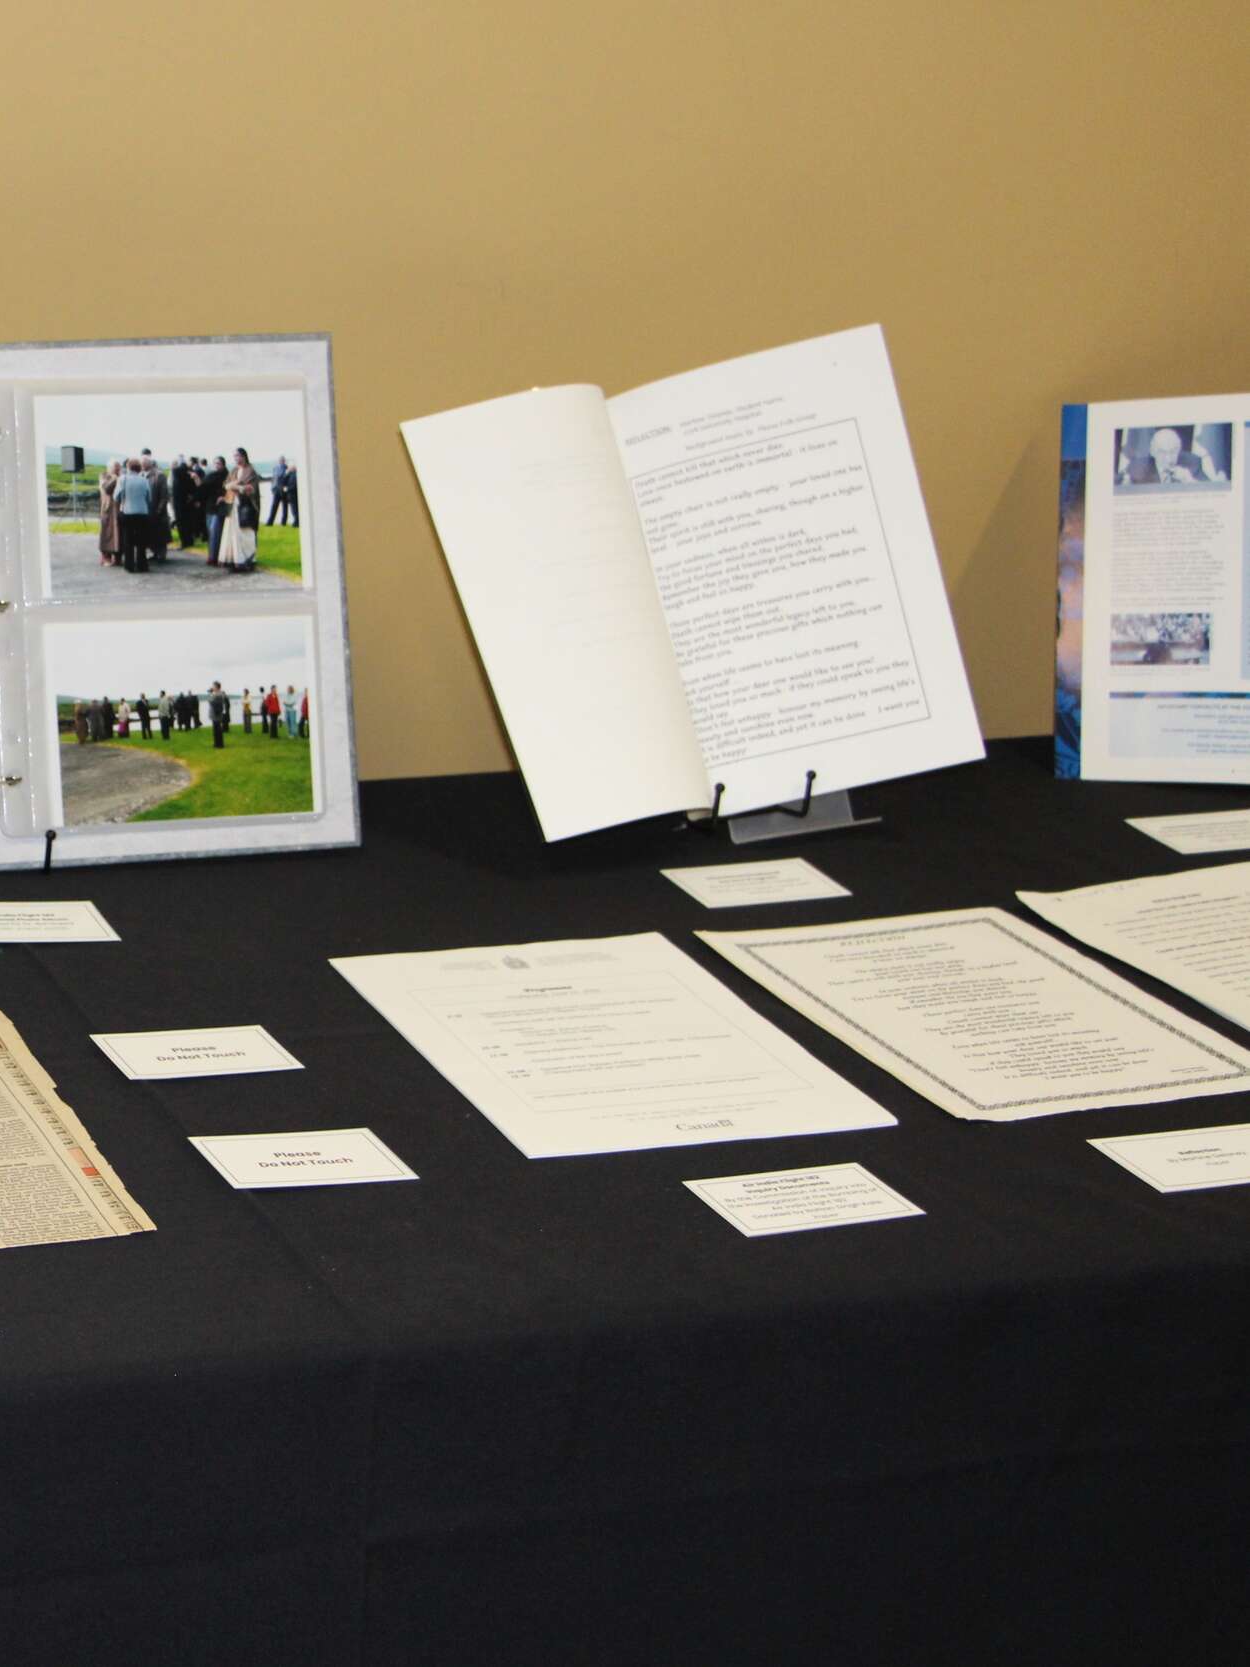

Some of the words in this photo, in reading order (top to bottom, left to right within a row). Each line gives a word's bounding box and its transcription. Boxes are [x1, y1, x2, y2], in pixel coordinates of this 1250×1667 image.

[171, 1045, 217, 1053] Please
[177, 1053, 202, 1061] Not
[203, 1050, 247, 1059] Touch
[274, 1150, 321, 1158] Please
[258, 1160, 279, 1168] Do
[280, 1159, 307, 1167] Not
[308, 1156, 353, 1165] Touch
